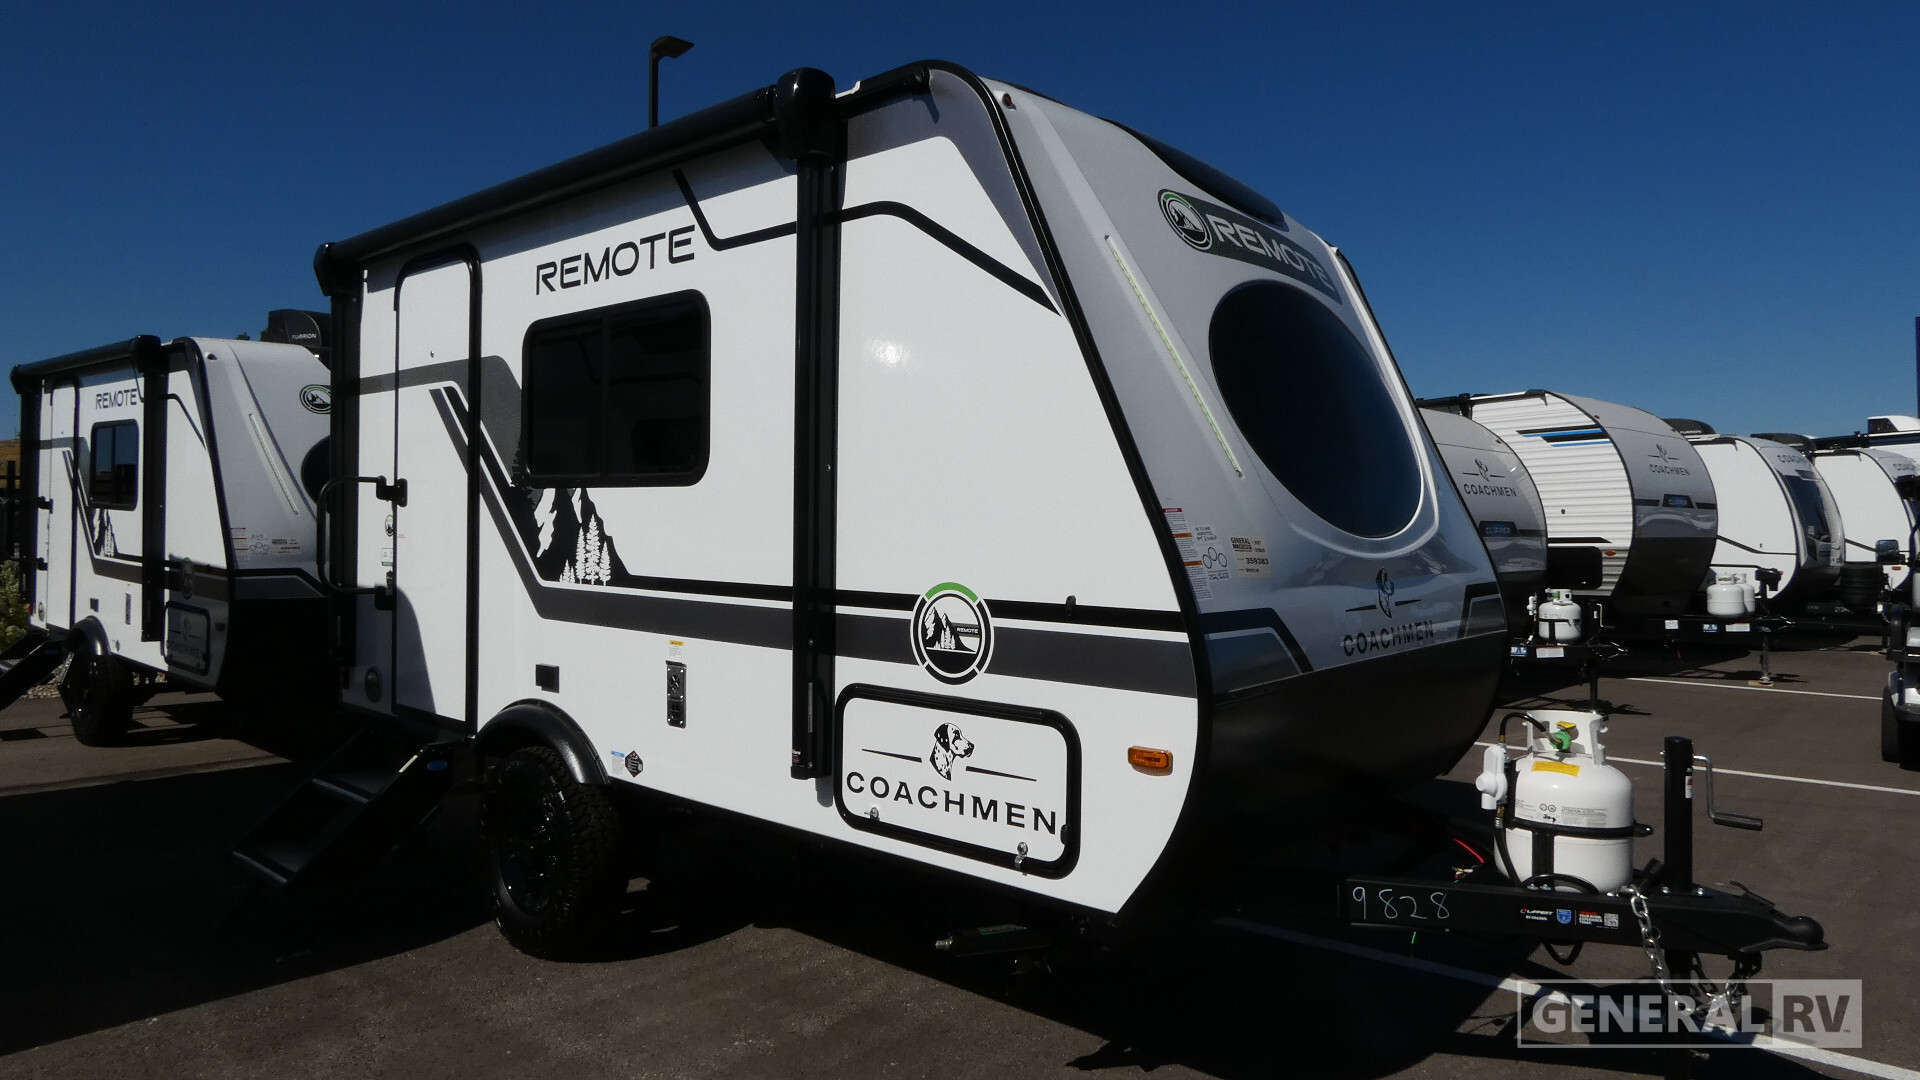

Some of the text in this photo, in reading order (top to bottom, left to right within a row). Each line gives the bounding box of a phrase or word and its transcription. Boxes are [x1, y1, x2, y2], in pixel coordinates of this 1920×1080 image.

[536, 224, 695, 296] REMOTE
[1205, 213, 1335, 292] REMOTE
[95, 388, 138, 410] REMOTE
[1649, 463, 1690, 476] COACHMEN
[1463, 483, 1518, 497] COACHMEN
[1343, 619, 1434, 657] COACHMEN
[846, 771, 1057, 835] COACHMEN
[1352, 886, 1450, 920] 9828
